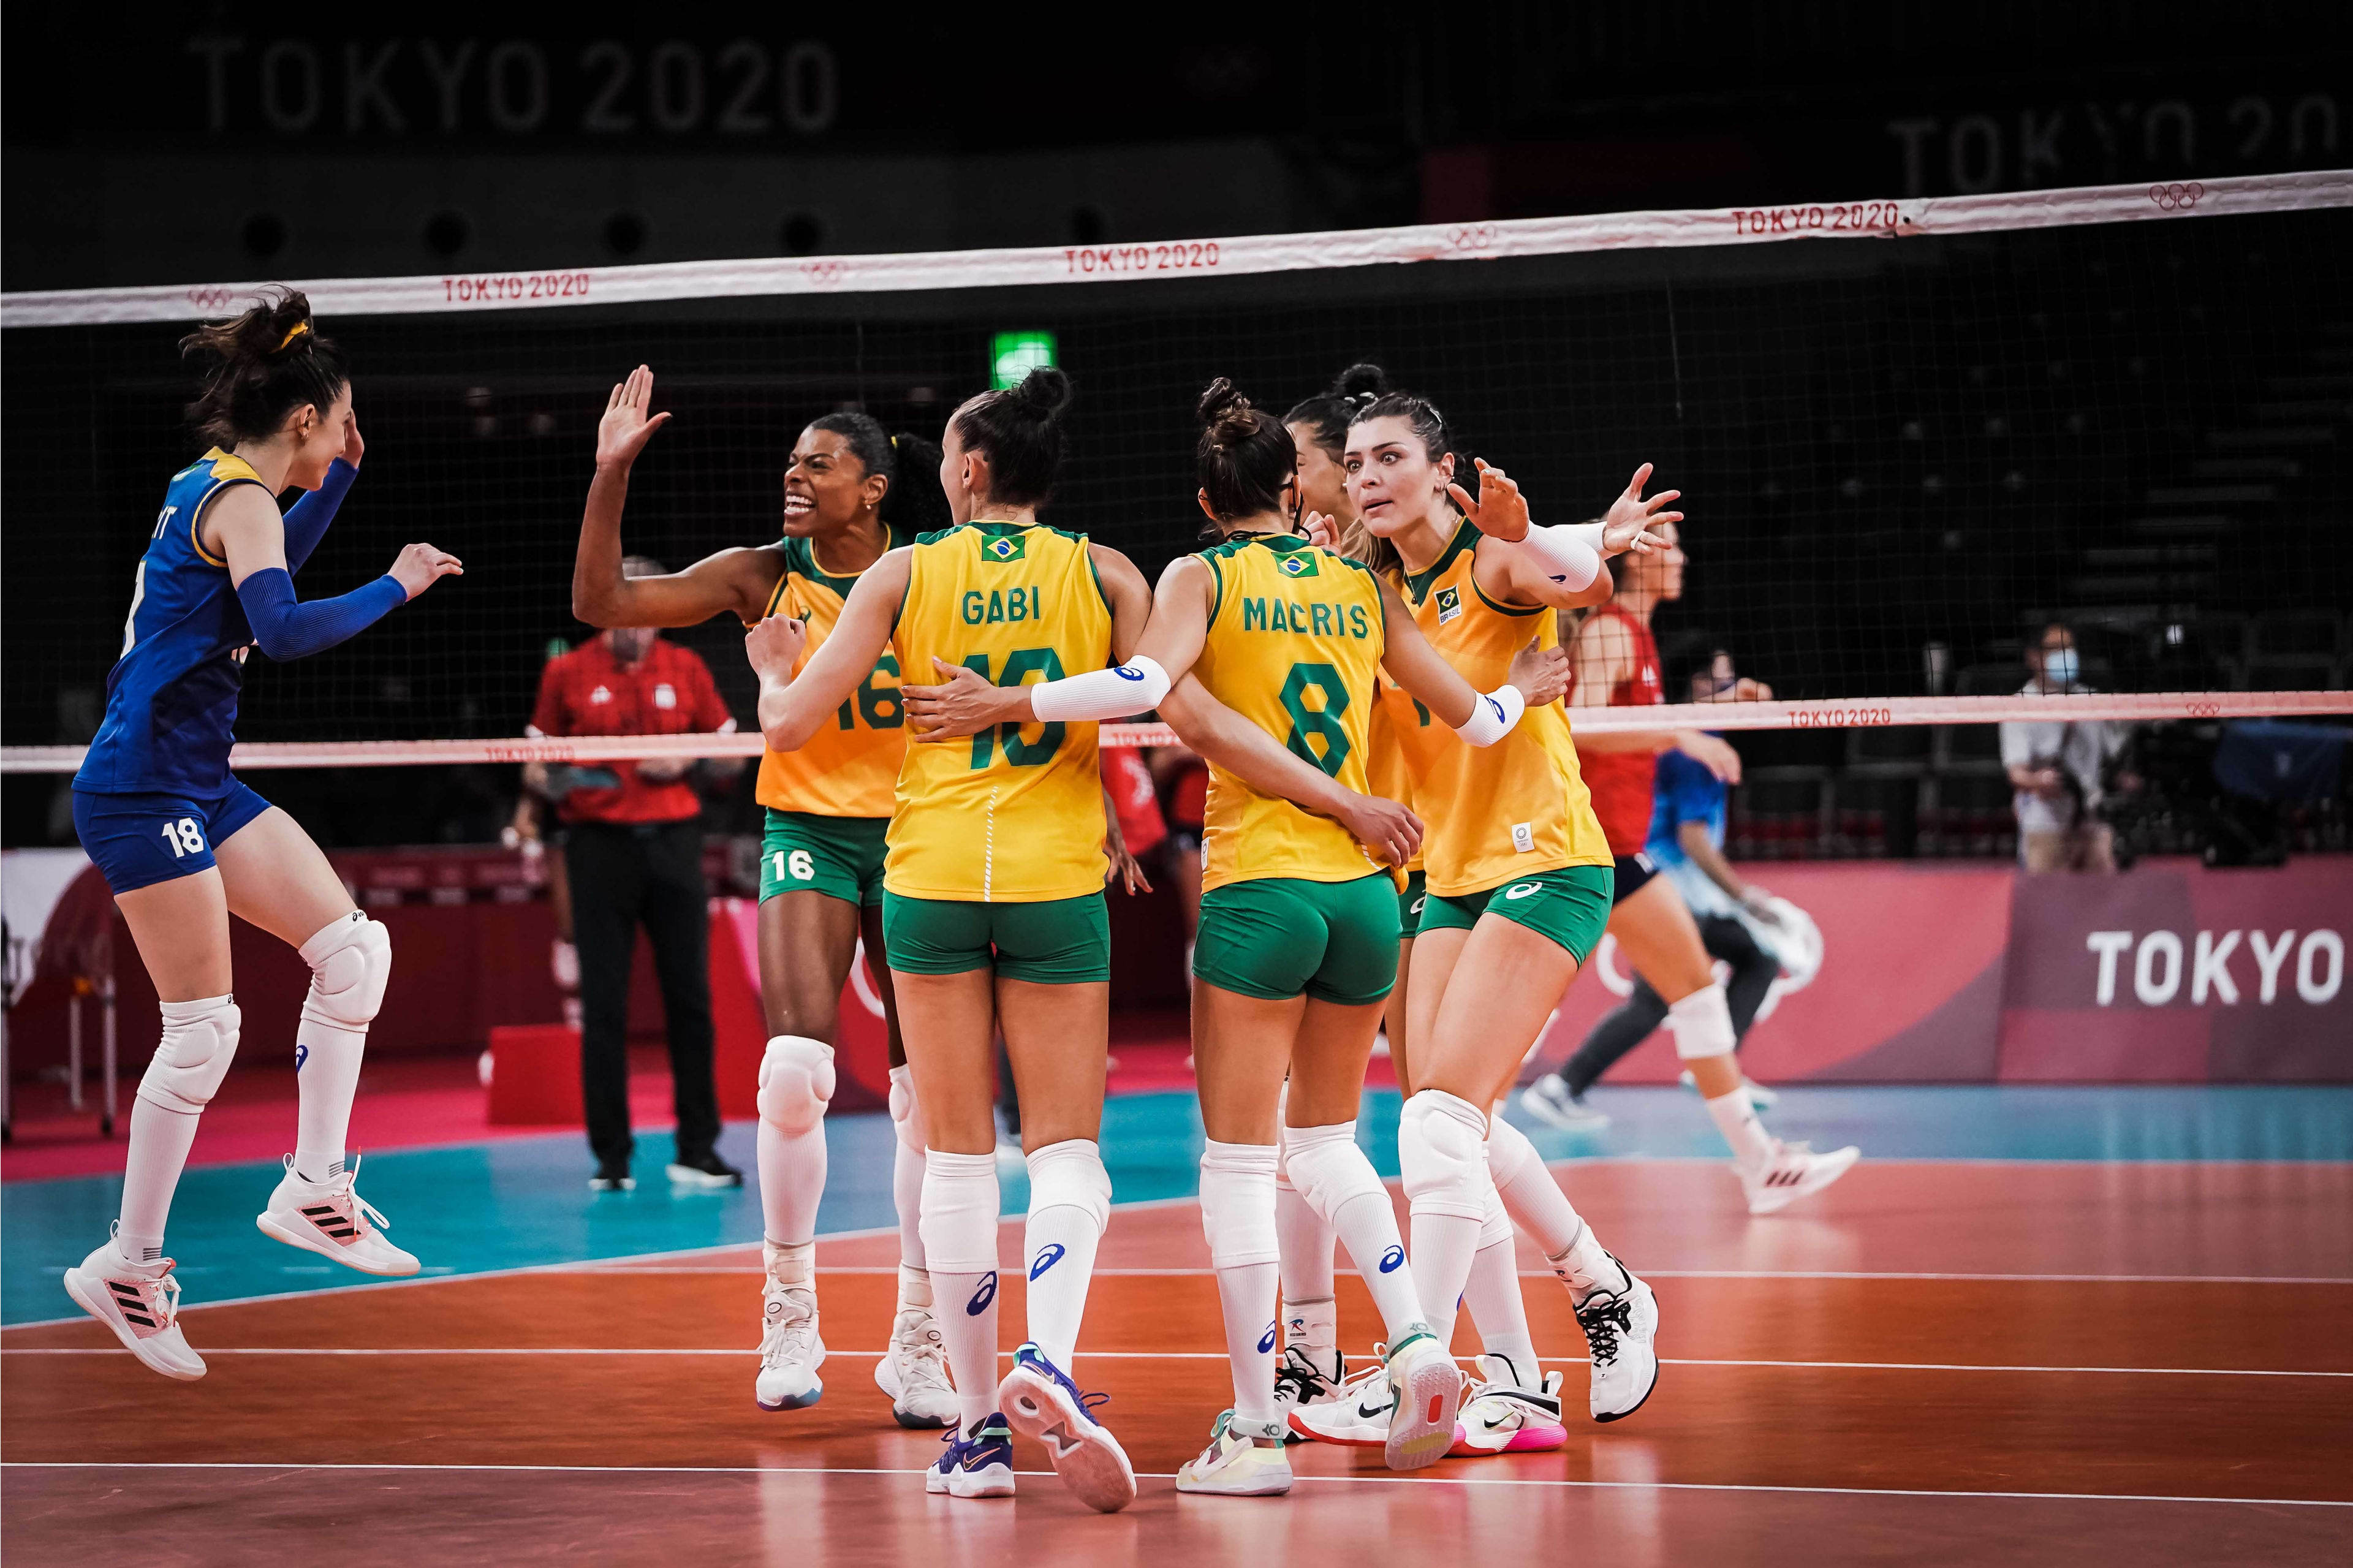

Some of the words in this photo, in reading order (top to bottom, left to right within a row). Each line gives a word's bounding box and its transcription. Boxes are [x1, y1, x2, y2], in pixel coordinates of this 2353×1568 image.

[189, 37, 551, 134] TOKYO
[579, 37, 841, 132] 2020
[1732, 206, 1824, 234] TOKYO
[1833, 202, 1898, 229] 2020
[1065, 246, 1149, 272] TOKYO
[1155, 243, 1219, 268] 2020
[442, 277, 523, 301] TOKYO
[528, 273, 588, 297] 2020
[962, 586, 1040, 626] GABI
[1243, 597, 1368, 639] MACRIS
[1279, 662, 1351, 778] 8
[1788, 711, 1844, 727] TOKYO
[1849, 708, 1890, 725] 2020
[162, 817, 204, 857] 18
[772, 849, 815, 881] 16
[2086, 929, 2345, 1006] TOKYO
